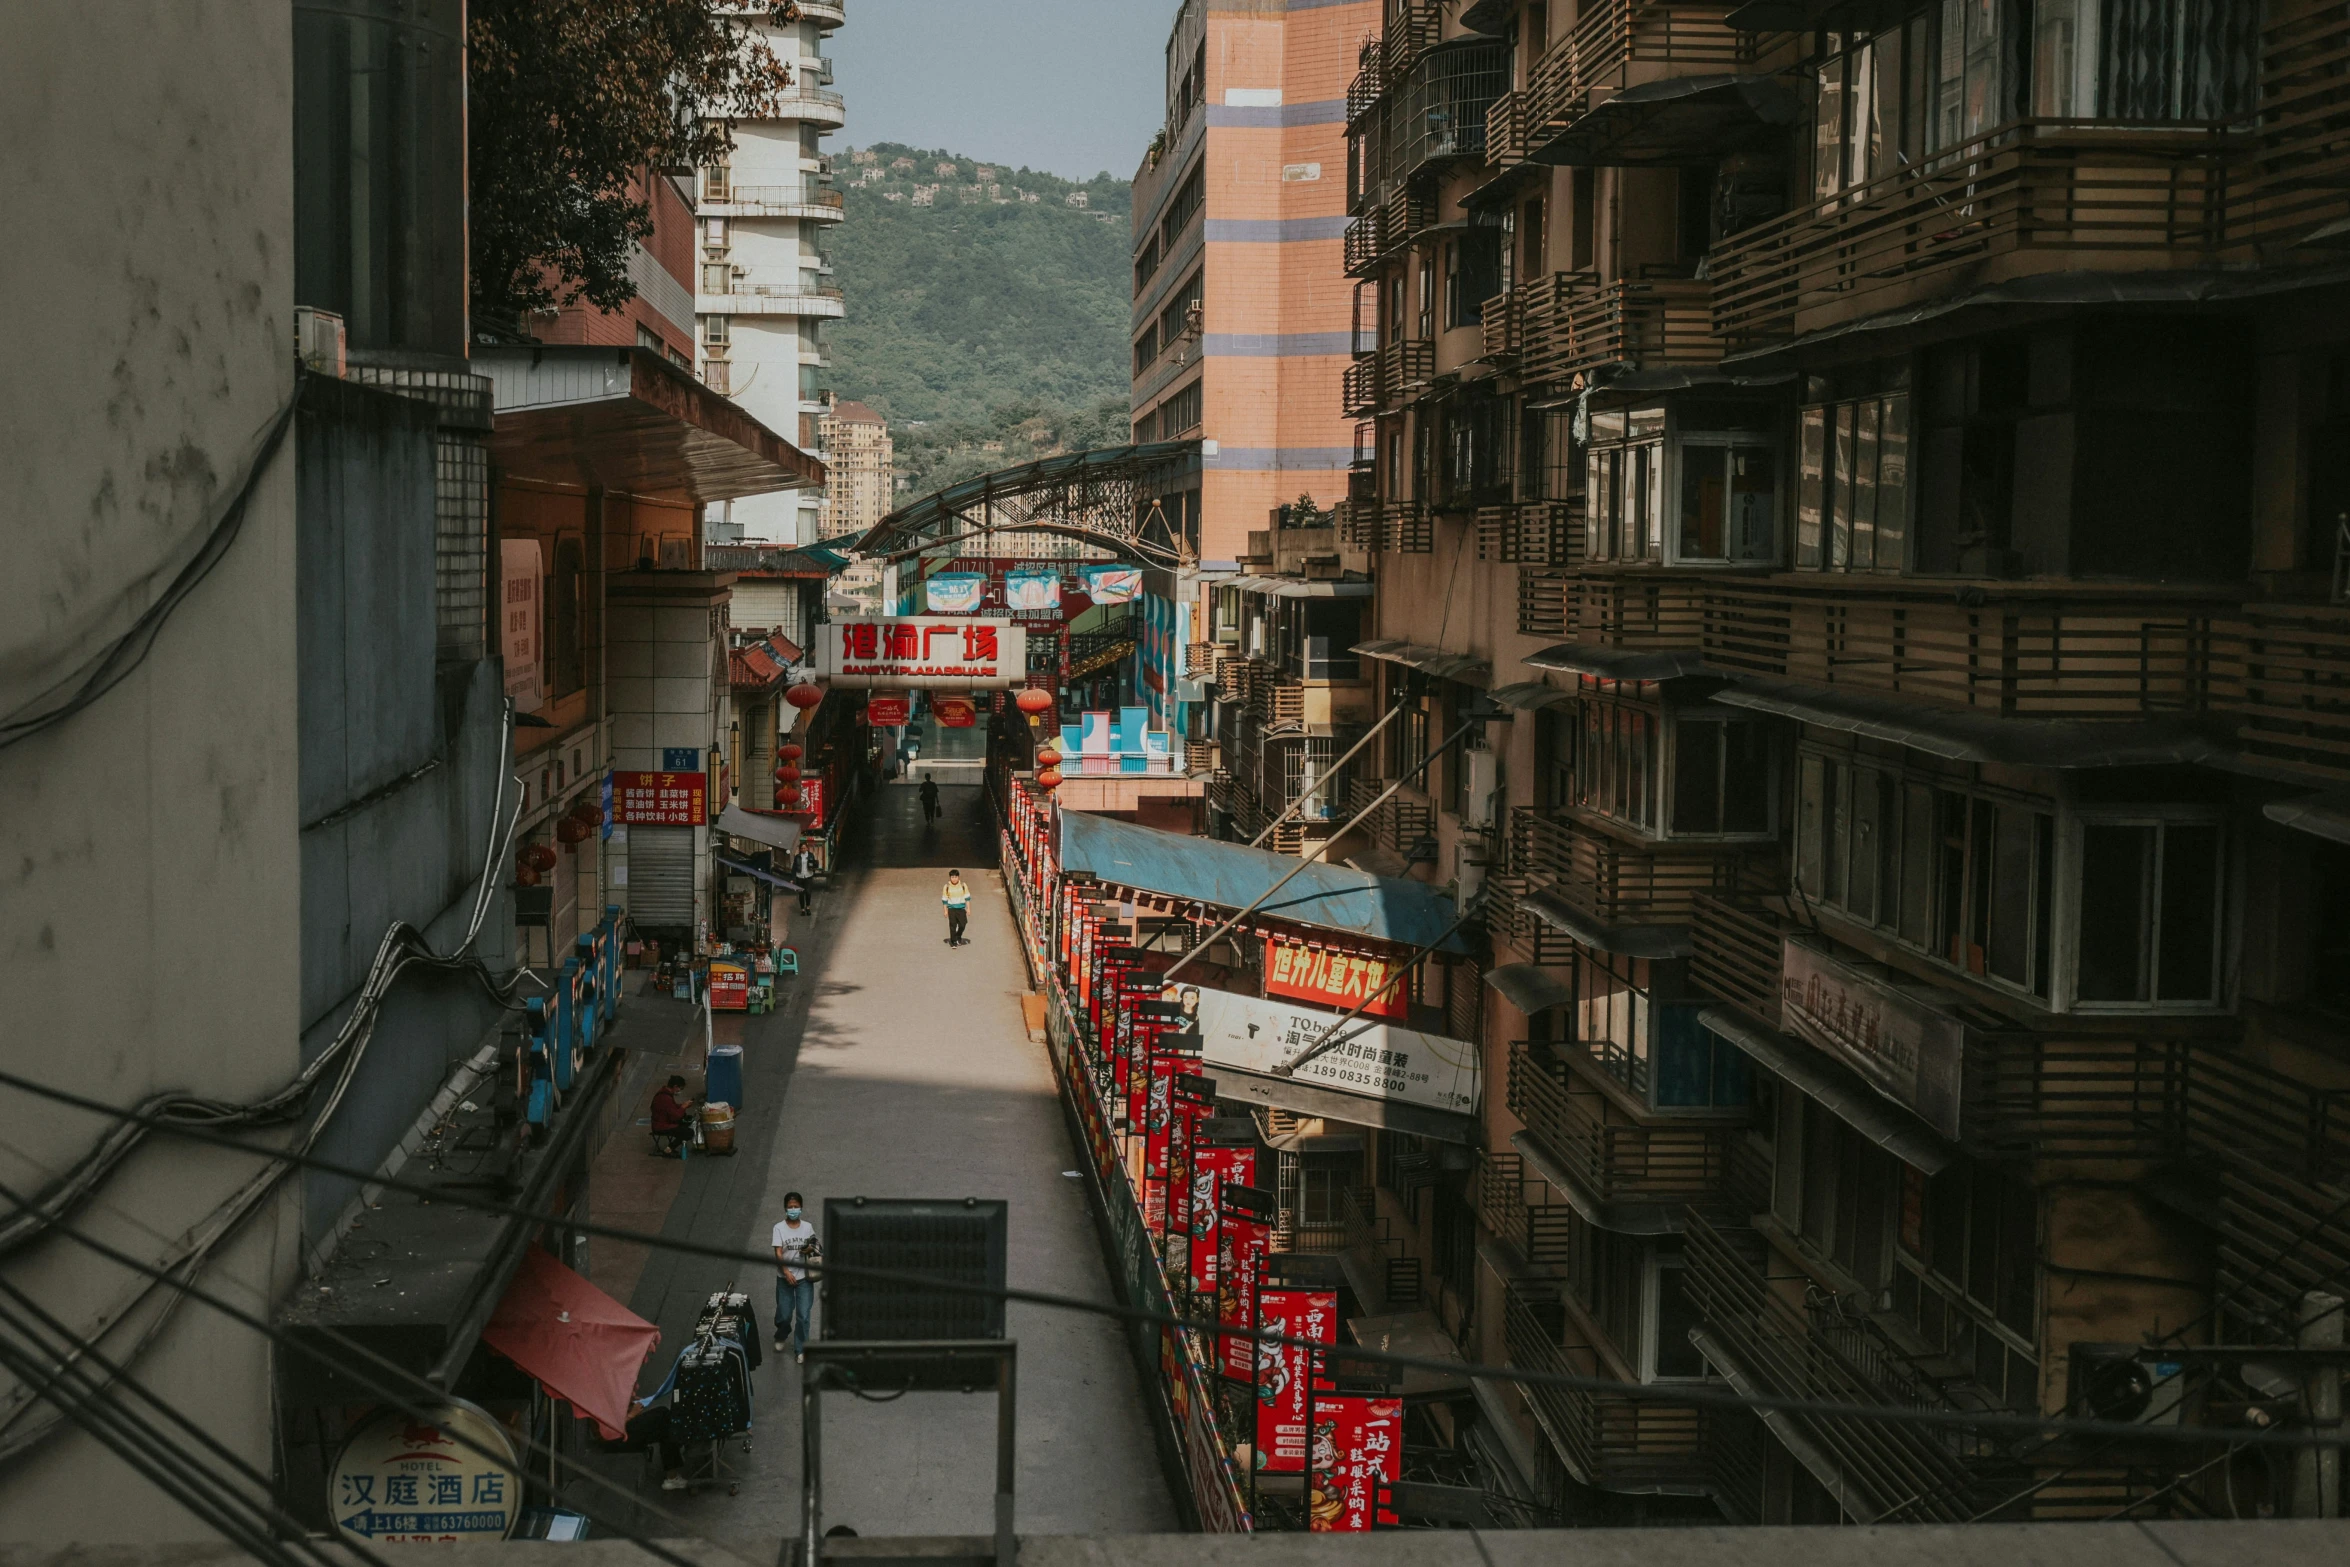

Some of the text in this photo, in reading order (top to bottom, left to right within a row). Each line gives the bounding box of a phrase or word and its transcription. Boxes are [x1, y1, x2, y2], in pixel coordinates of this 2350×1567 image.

[981, 608, 1063, 620] 诚招区县加盟商
[843, 623, 998, 662] 港渝广场
[675, 758, 686, 767] 61
[640, 773, 676, 787] 饼子
[625, 788, 689, 798] 酱香饼 韭菜饼
[625, 800, 689, 809] 葱油饼 玉米饼
[692, 788, 703, 823] 现磨豆浆
[625, 812, 689, 822] 各种饮料 小吃
[723, 973, 746, 981] 招聘
[1272, 941, 1402, 1006] 恒升儿童大世界
[1364, 1419, 1391, 1483] 一站式
[401, 1462, 442, 1471] HOTEL
[342, 1472, 505, 1506] 汉庭酒店
[1348, 1448, 1367, 1532] 鞋服采购基
[352, 1515, 417, 1531] 请上16楼
[441, 1513, 502, 1530] 63760000
